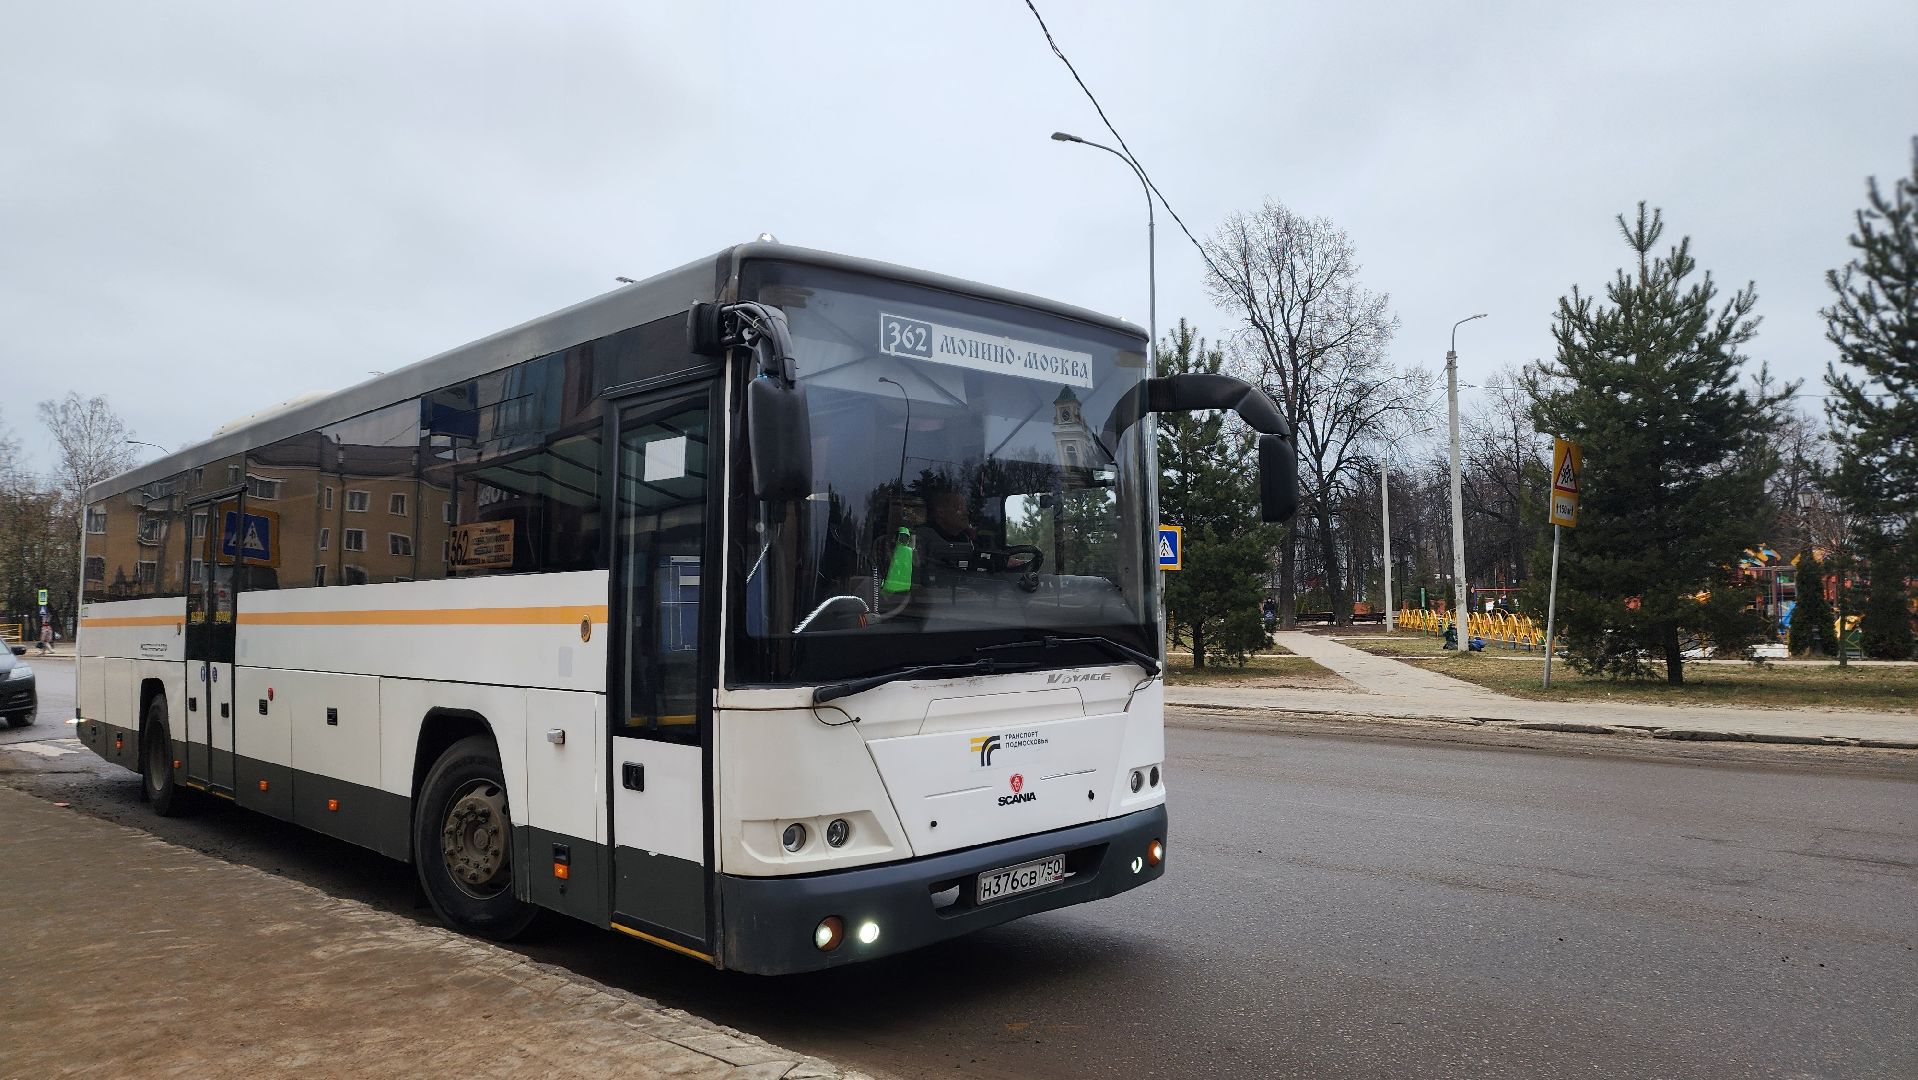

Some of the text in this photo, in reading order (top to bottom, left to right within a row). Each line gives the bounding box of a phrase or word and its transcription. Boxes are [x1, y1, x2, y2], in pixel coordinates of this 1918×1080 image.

[888, 321, 927, 352] 362
[450, 529, 469, 566] 362
[1005, 731, 1039, 741] ТРАНСПОРТ
[1005, 738, 1049, 749] ПОДМОСКОВЬЯ
[998, 792, 1037, 806] SCANIA
[1040, 860, 1061, 877] 750
